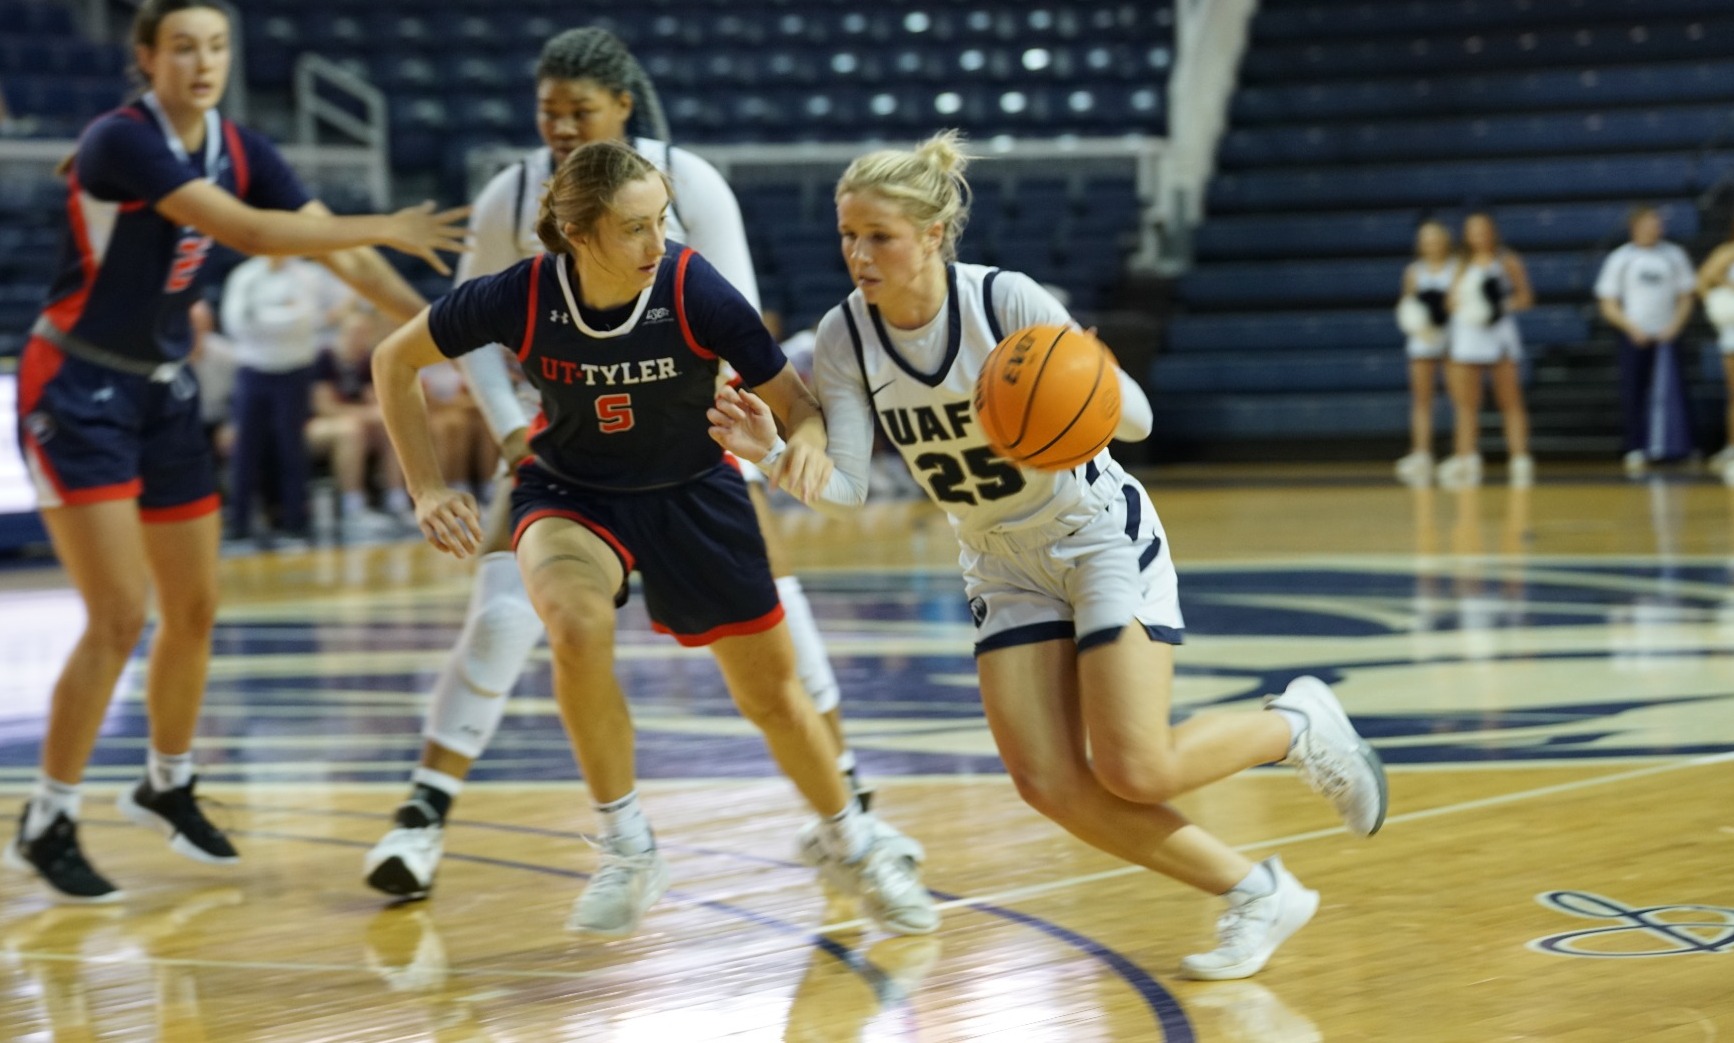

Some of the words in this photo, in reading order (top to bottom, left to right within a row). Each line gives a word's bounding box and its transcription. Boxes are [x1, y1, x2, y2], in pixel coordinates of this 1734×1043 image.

[595, 393, 635, 434] 5
[881, 400, 973, 445] UAF
[914, 445, 1027, 506] 25
